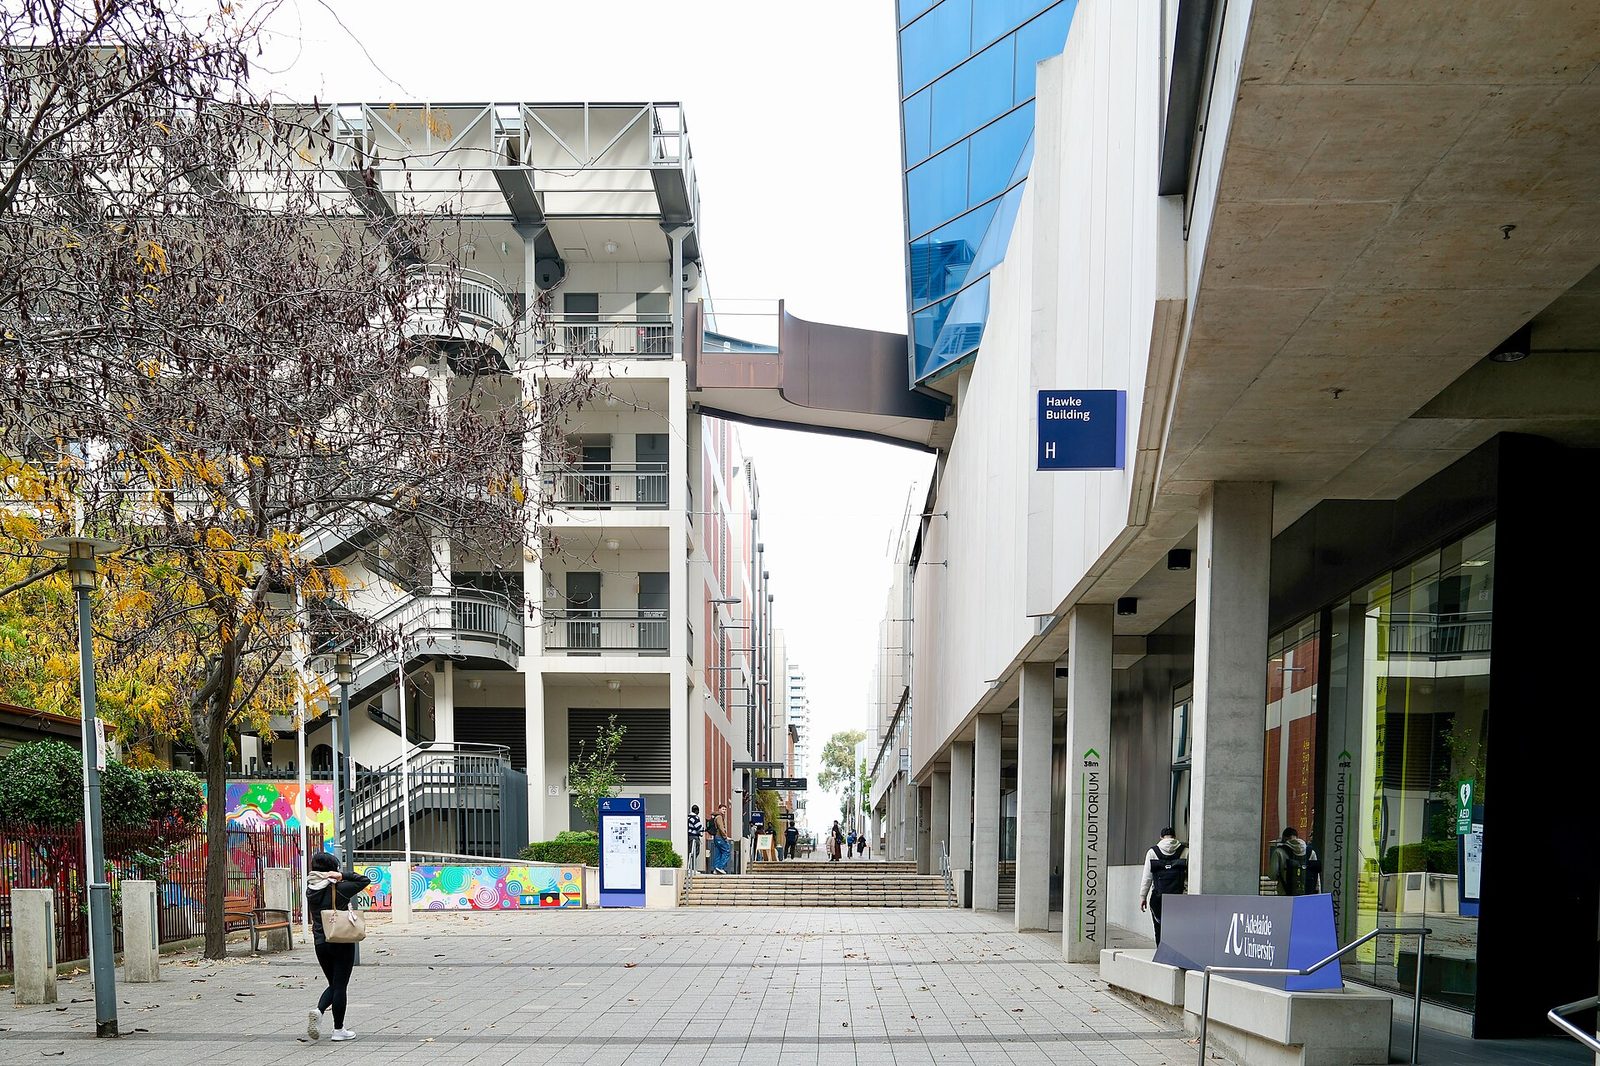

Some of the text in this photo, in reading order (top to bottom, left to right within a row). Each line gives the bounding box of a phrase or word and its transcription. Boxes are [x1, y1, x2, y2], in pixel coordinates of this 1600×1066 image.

[1046, 397, 1082, 407] Hawke
[1046, 410, 1090, 421] Building
[1045, 441, 1056, 459] H
[1458, 808, 1470, 818] AED
[1085, 772, 1099, 942] ALLAN SCOTT AUDITORIUM
[1244, 913, 1272, 936] Adelaide
[1244, 936, 1276, 967] University
